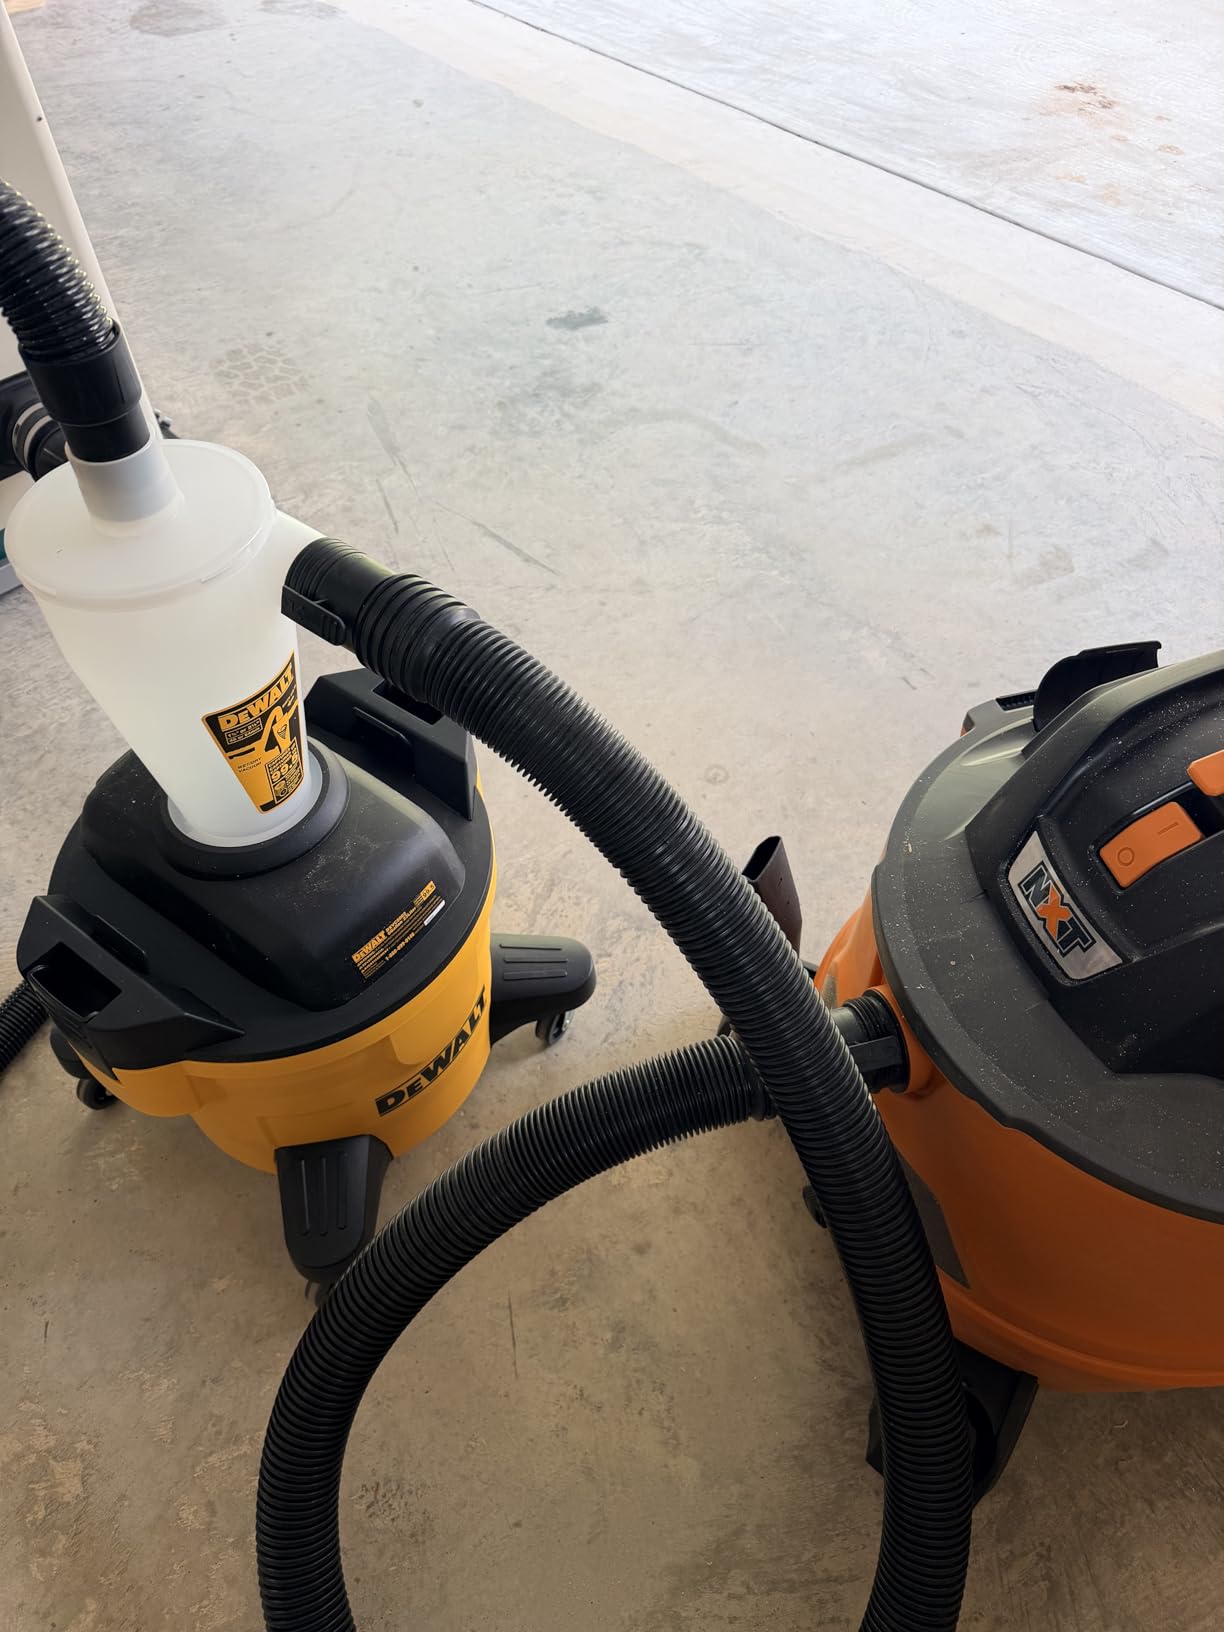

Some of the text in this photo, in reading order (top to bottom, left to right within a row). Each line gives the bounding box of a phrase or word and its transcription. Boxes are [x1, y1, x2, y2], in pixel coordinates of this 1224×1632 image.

[218, 663, 294, 730] DEWALT
[1018, 861, 1096, 958] NXT
[375, 985, 486, 1114] DEWALT
